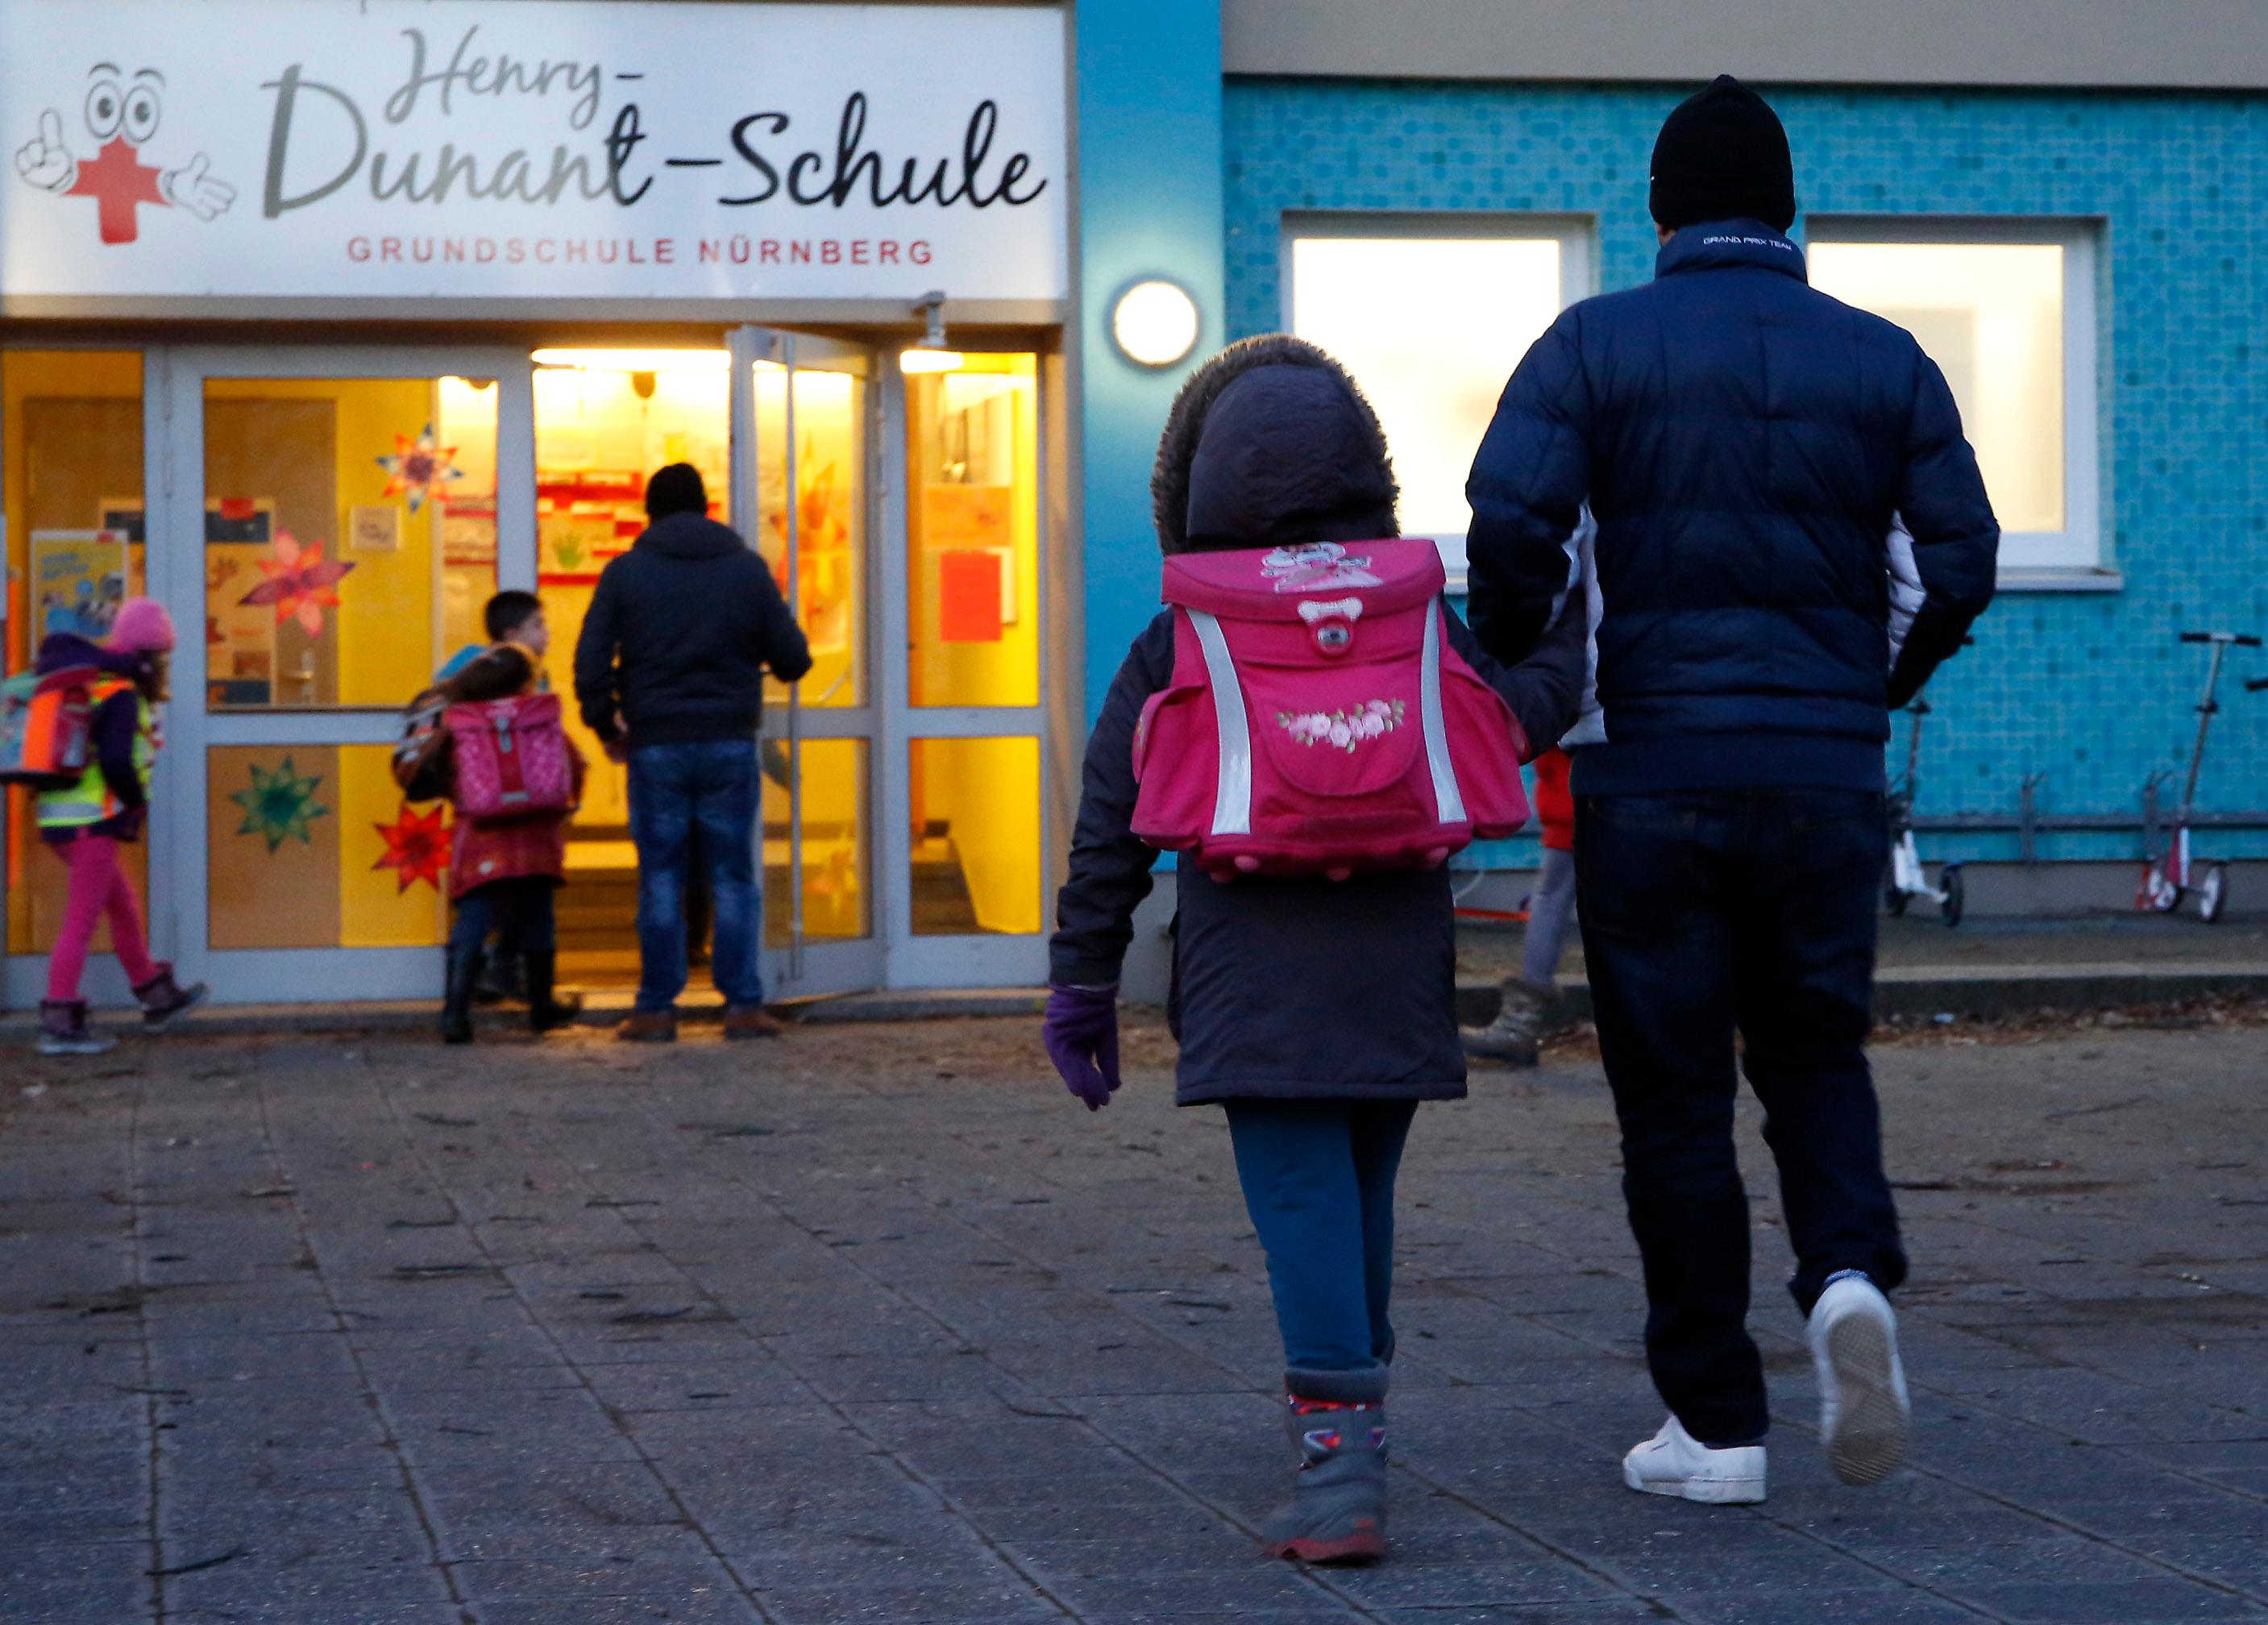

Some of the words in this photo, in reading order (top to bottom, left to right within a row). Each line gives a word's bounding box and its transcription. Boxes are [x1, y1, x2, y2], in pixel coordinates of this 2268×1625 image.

[383, 24, 644, 130] Henry-
[259, 64, 1047, 219] Dunant-Schule
[347, 236, 675, 264] GRUNDSCHULE
[699, 233, 934, 265] NÜRNBERG
[1703, 235, 1742, 245] GRAND
[1743, 237, 1767, 245] PRIX
[1769, 239, 1792, 251] TEAM
